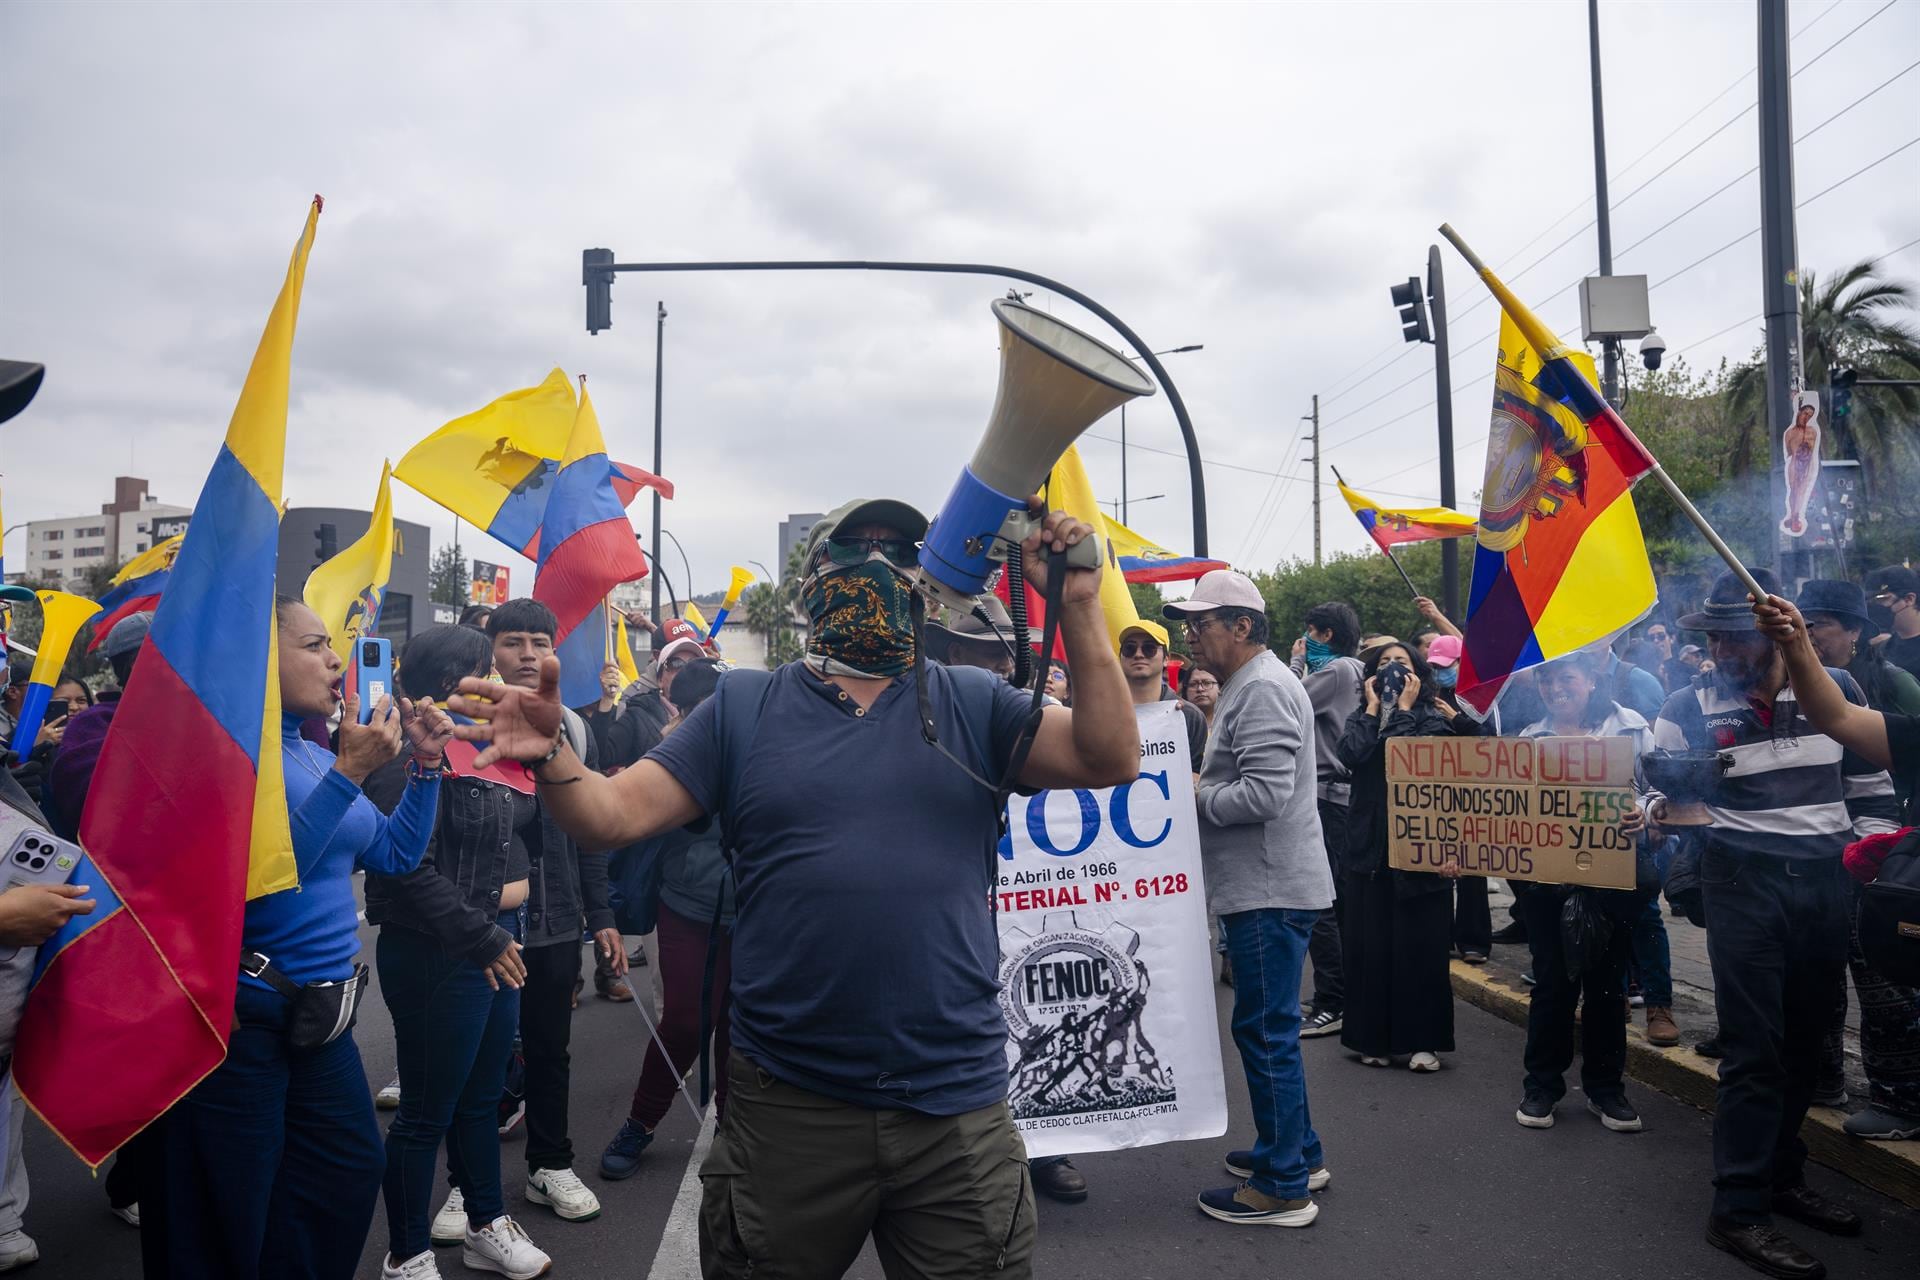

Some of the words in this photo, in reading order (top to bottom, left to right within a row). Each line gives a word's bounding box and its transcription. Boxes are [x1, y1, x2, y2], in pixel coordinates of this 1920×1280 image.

[1390, 742, 1435, 778] NO
[1440, 741, 1472, 779] AL
[1475, 740, 1608, 782] SAQUEO
[1394, 783, 1432, 809] LOS
[1433, 784, 1492, 815] FONDOS
[1494, 788, 1529, 817] SON
[1540, 789, 1578, 818] DEL
[1395, 815, 1421, 840] DE
[1424, 817, 1459, 842] LOS
[1589, 826, 1632, 850] LOS
[1014, 868, 1051, 885] Abril
[1057, 867, 1075, 881] de
[1081, 862, 1117, 878] 1966
[1135, 873, 1188, 898] 6128
[1024, 957, 1110, 1004] FENOC
[1049, 1005, 1065, 1014] SET
[1026, 1120, 1038, 1130] DE
[1040, 1117, 1071, 1129] CEDOC
[1073, 1103, 1178, 1126] CLAT-FETALCA-FCL-FMTA
